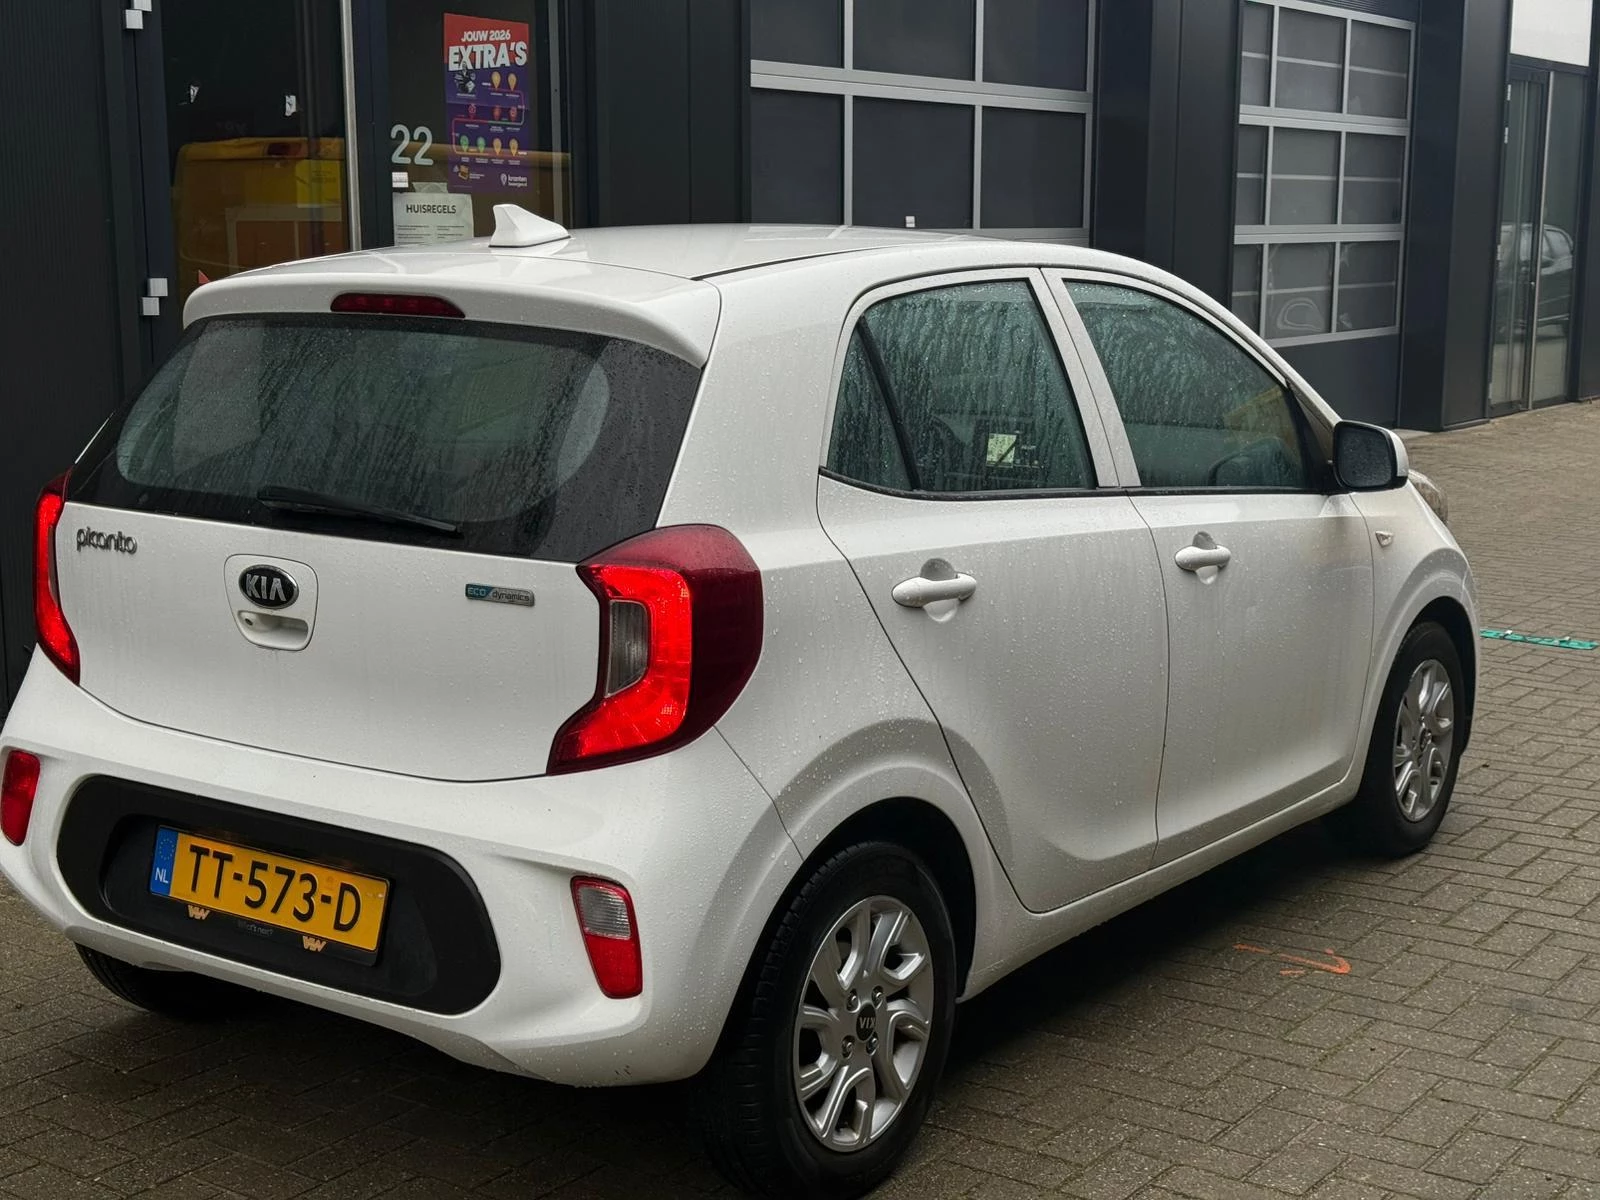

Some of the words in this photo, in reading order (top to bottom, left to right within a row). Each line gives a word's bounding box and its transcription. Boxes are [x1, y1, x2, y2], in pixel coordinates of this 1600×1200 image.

[461, 30, 488, 42] JOUW
[489, 30, 511, 41] 2026
[448, 41, 528, 71] EXTRA'S
[391, 124, 434, 165] 22
[406, 204, 457, 214] HUISREGELS
[77, 527, 137, 554] picanto
[246, 573, 286, 602] KIA
[154, 867, 169, 884] NL
[188, 844, 362, 932] TT-573-D
